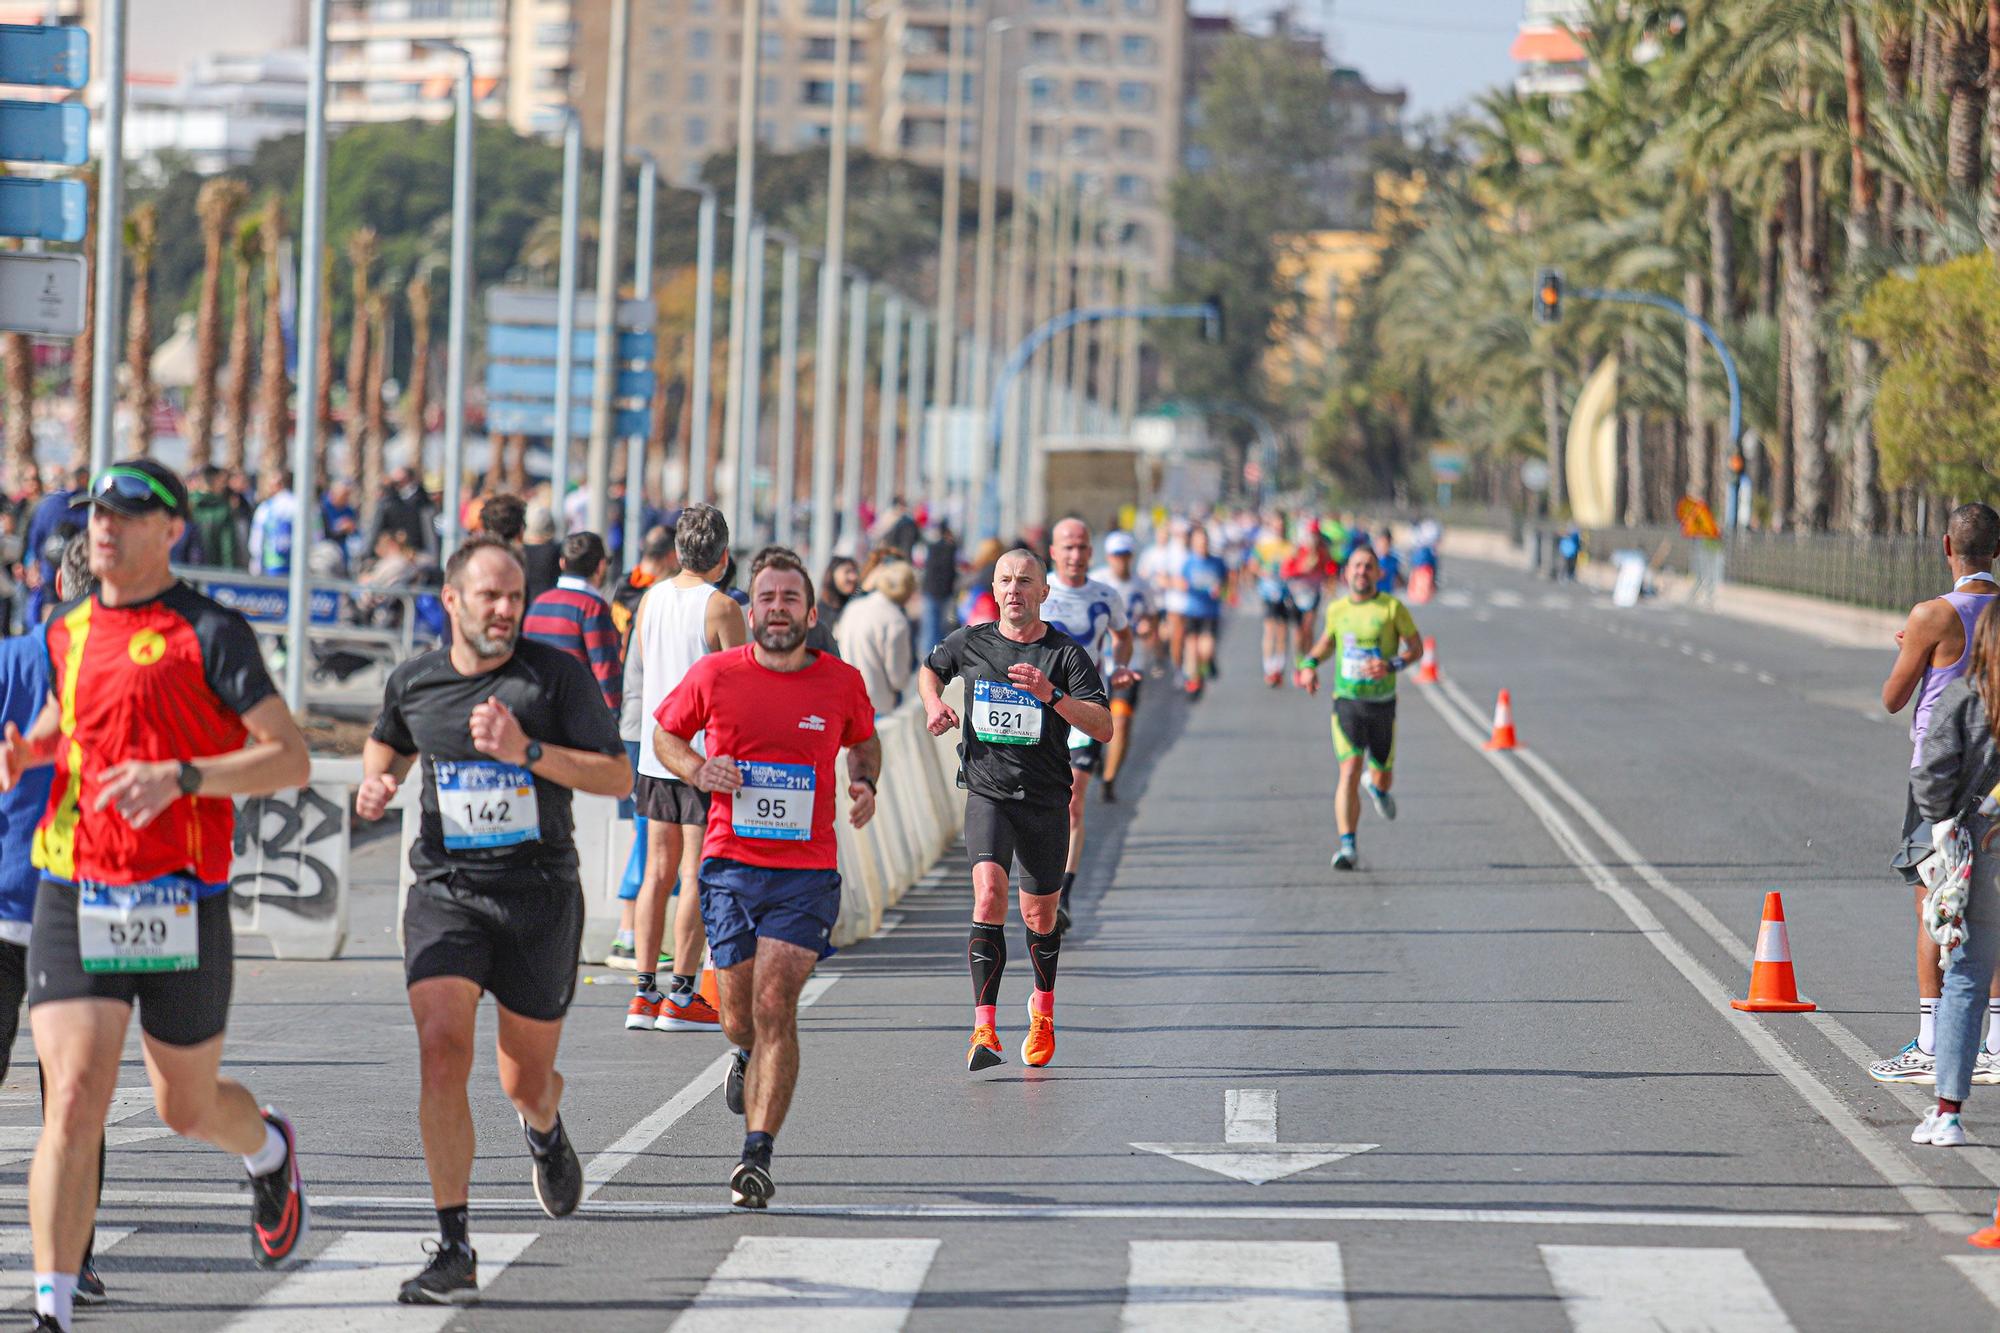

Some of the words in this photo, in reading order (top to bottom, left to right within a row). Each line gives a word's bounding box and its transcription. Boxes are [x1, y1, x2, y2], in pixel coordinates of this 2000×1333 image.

[1018, 696, 1036, 707] 21K
[989, 711, 1022, 729] 621
[786, 776, 811, 790] 21K
[464, 801, 512, 825] 142
[757, 799, 786, 819] 95
[109, 919, 167, 945] 529
